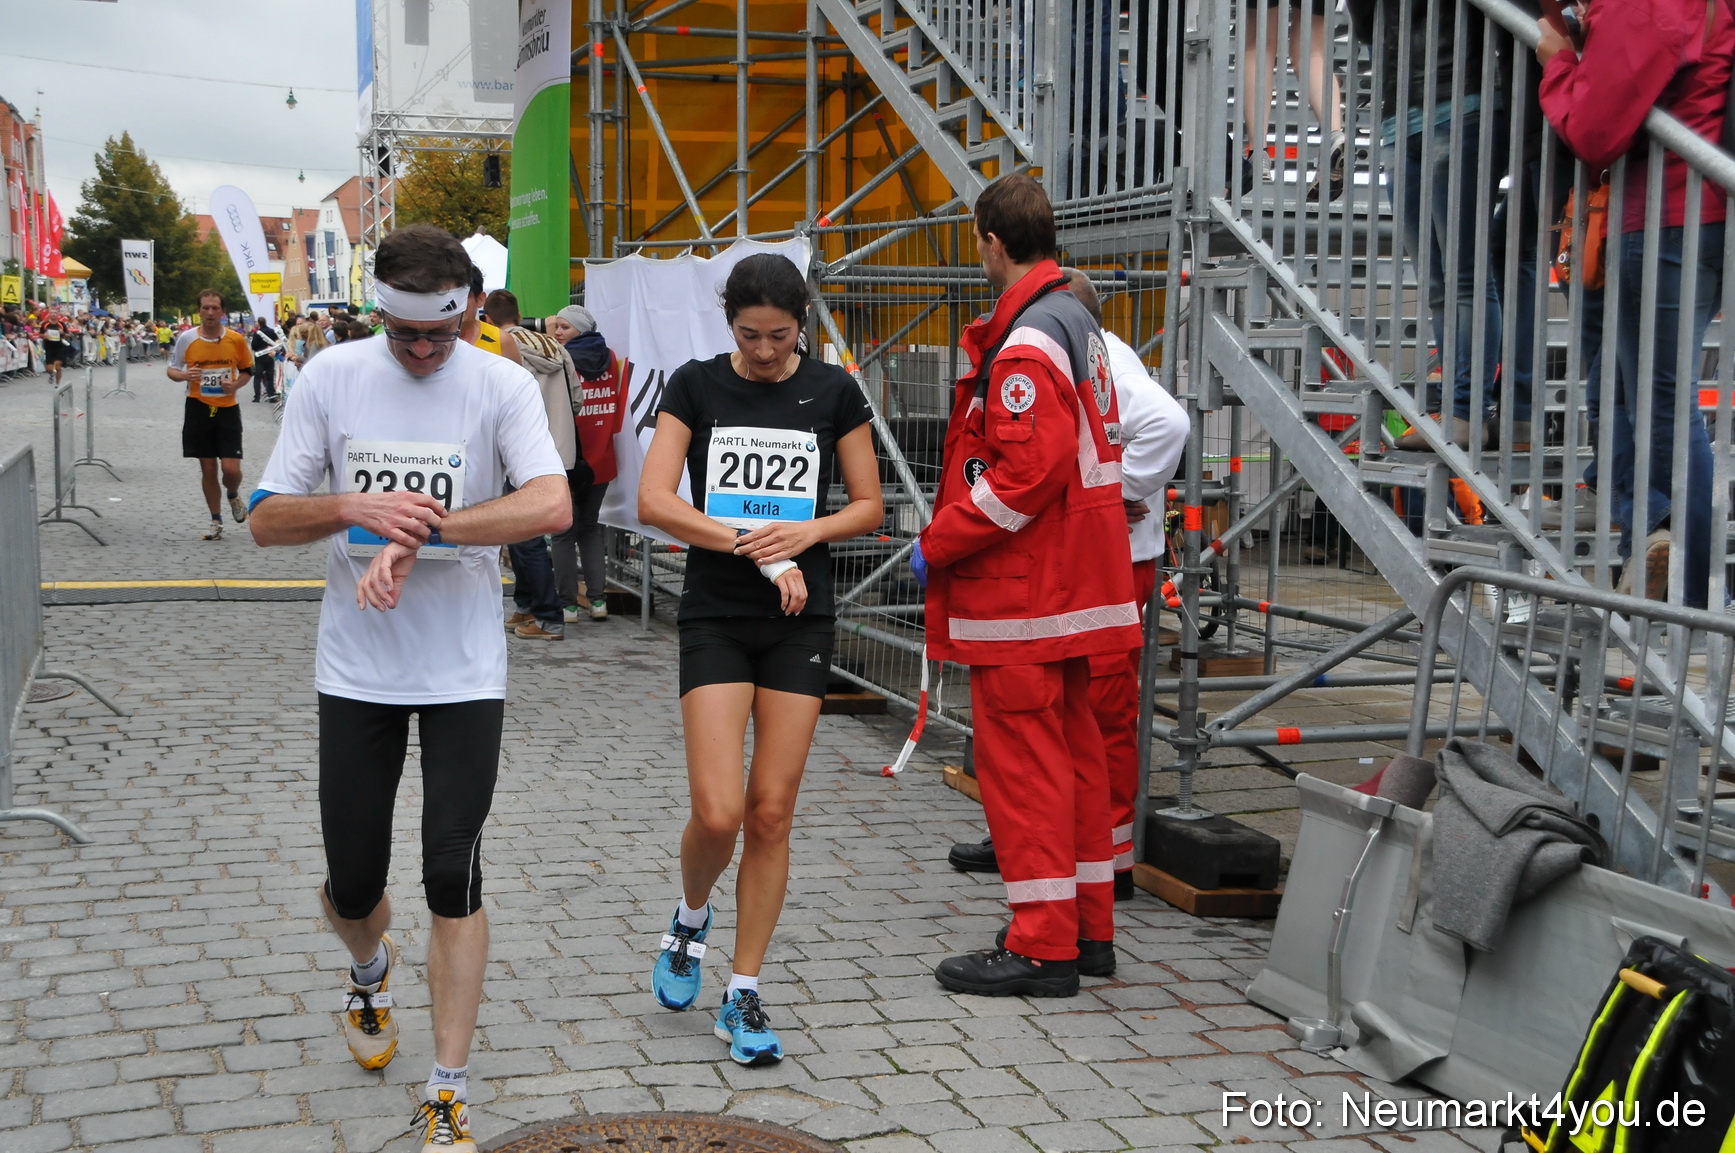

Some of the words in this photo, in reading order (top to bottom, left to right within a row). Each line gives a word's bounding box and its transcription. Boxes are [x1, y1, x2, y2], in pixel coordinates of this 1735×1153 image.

[6, 283, 17, 297] A
[1004, 376, 1032, 391] DEUTSCHES
[1004, 394, 1018, 411] ROTES
[1018, 393, 1033, 410] KREUZ
[712, 437, 748, 447] PARTL
[750, 438, 802, 450] Neumarkt
[347, 452, 380, 463] PARTL
[383, 453, 444, 466] Neumarkt
[719, 451, 809, 493] 2022
[354, 469, 453, 513] 2389
[743, 500, 780, 516] Karla
[435, 1067, 451, 1079] TECH
